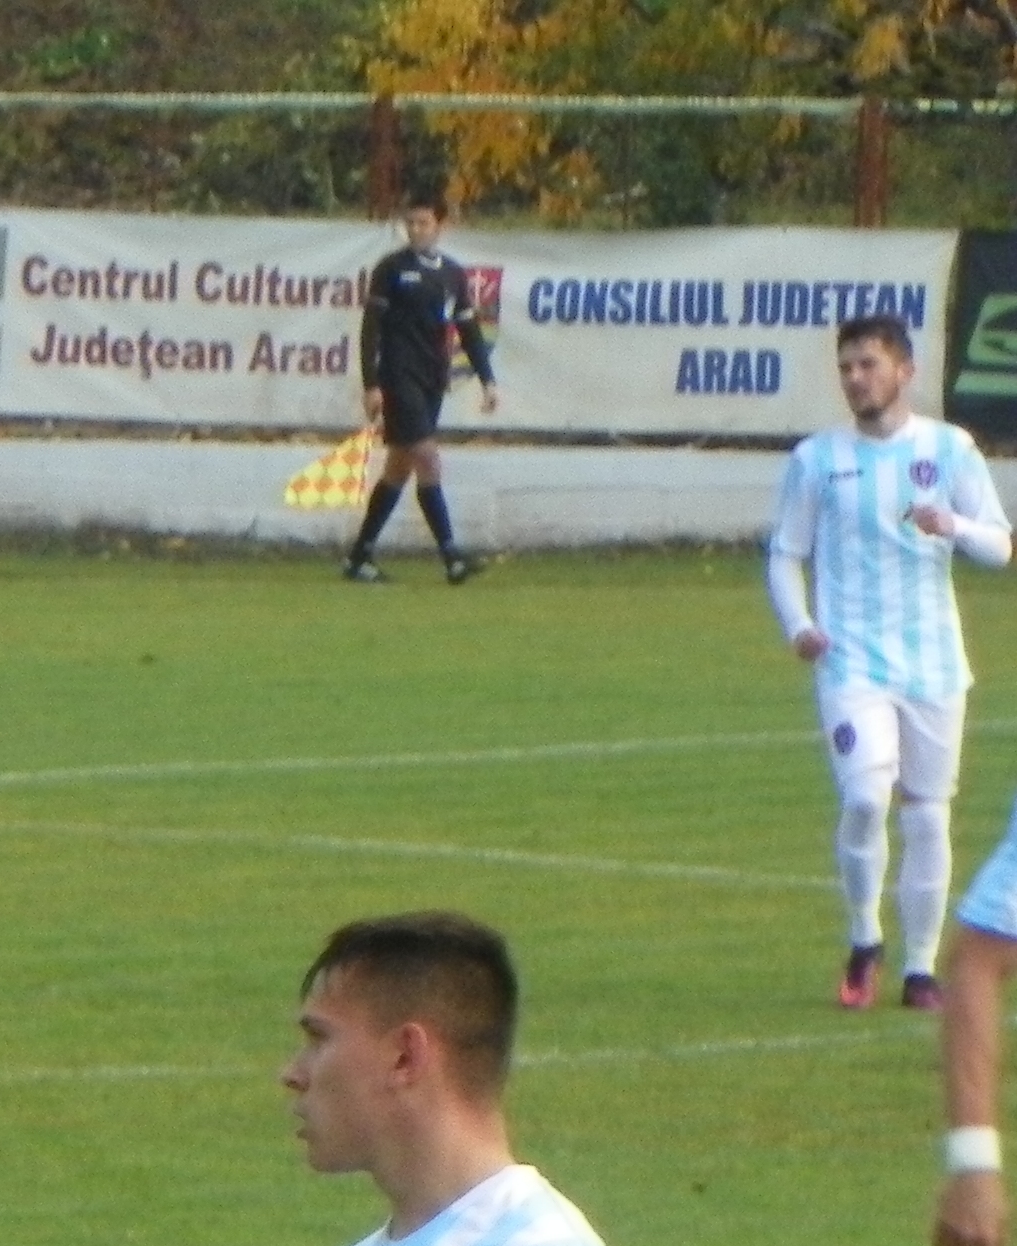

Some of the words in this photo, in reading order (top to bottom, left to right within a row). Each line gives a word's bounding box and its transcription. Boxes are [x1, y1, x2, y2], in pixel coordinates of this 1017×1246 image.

[21, 255, 179, 301] Centrul
[195, 260, 370, 308] Cultural
[528, 279, 728, 328] CONSILIUL
[248, 331, 350, 376] Arad
[675, 347, 782, 396] ARAD
